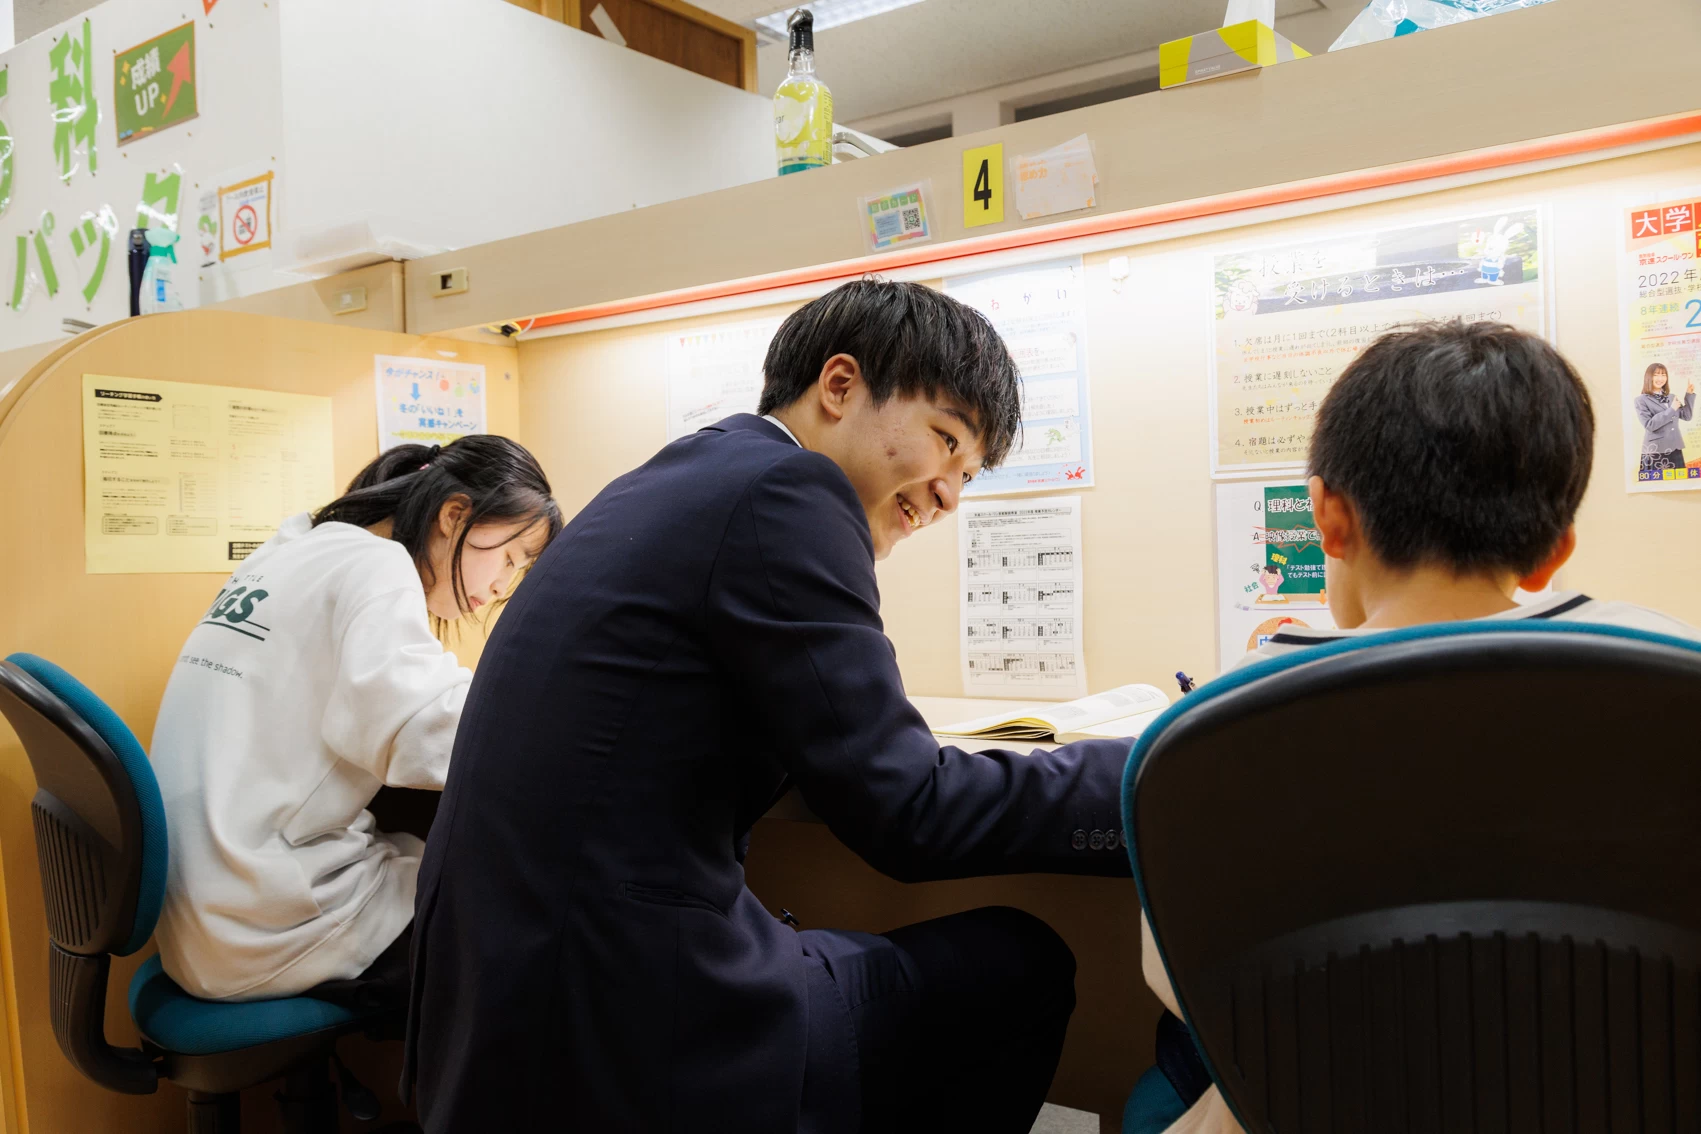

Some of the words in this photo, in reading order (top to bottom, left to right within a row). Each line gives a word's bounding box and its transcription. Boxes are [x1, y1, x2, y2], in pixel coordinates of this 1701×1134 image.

[131, 47, 160, 90] 成績
[135, 82, 160, 116] UP
[973, 159, 992, 210] 4
[1634, 205, 1701, 237] 大学
[1638, 268, 1701, 288] 2022年
[1244, 366, 1332, 384] 授業に遅刻しないこと
[189, 656, 200, 665] see
[200, 658, 213, 669] the
[213, 663, 244, 680] shadow.
